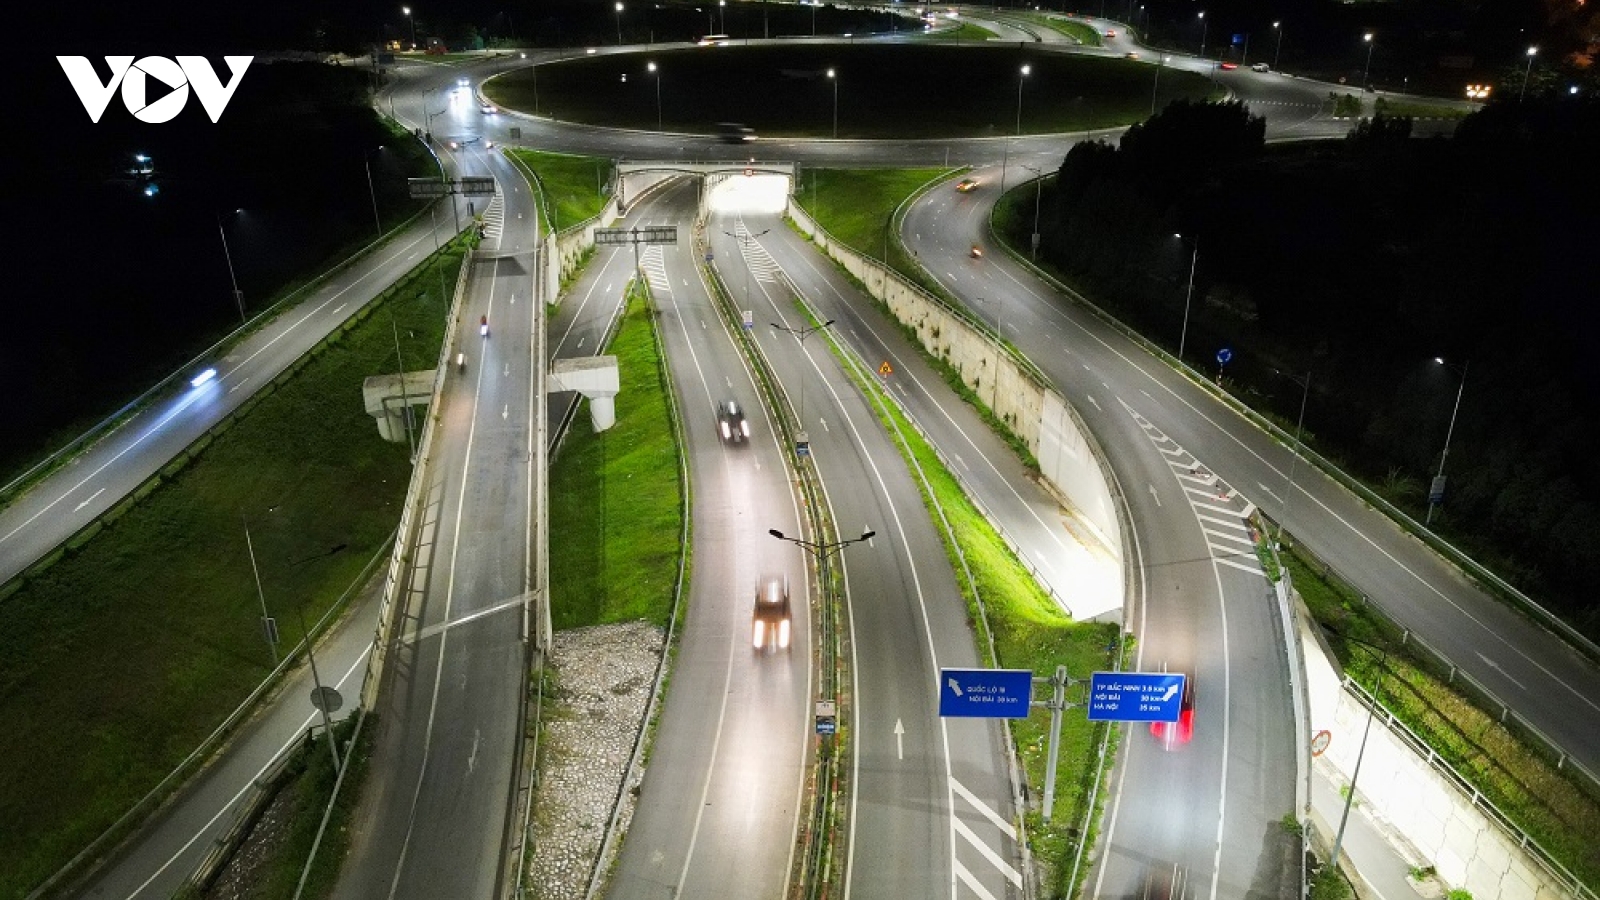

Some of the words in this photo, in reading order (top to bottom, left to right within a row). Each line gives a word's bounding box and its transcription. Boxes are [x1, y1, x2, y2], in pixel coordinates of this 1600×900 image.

[1123, 684, 1140, 692] NINH
[1153, 685, 1165, 693] km
[969, 695, 981, 703] NỘI
[1095, 693, 1107, 701] NỘI
[1105, 703, 1119, 711] NỘI
